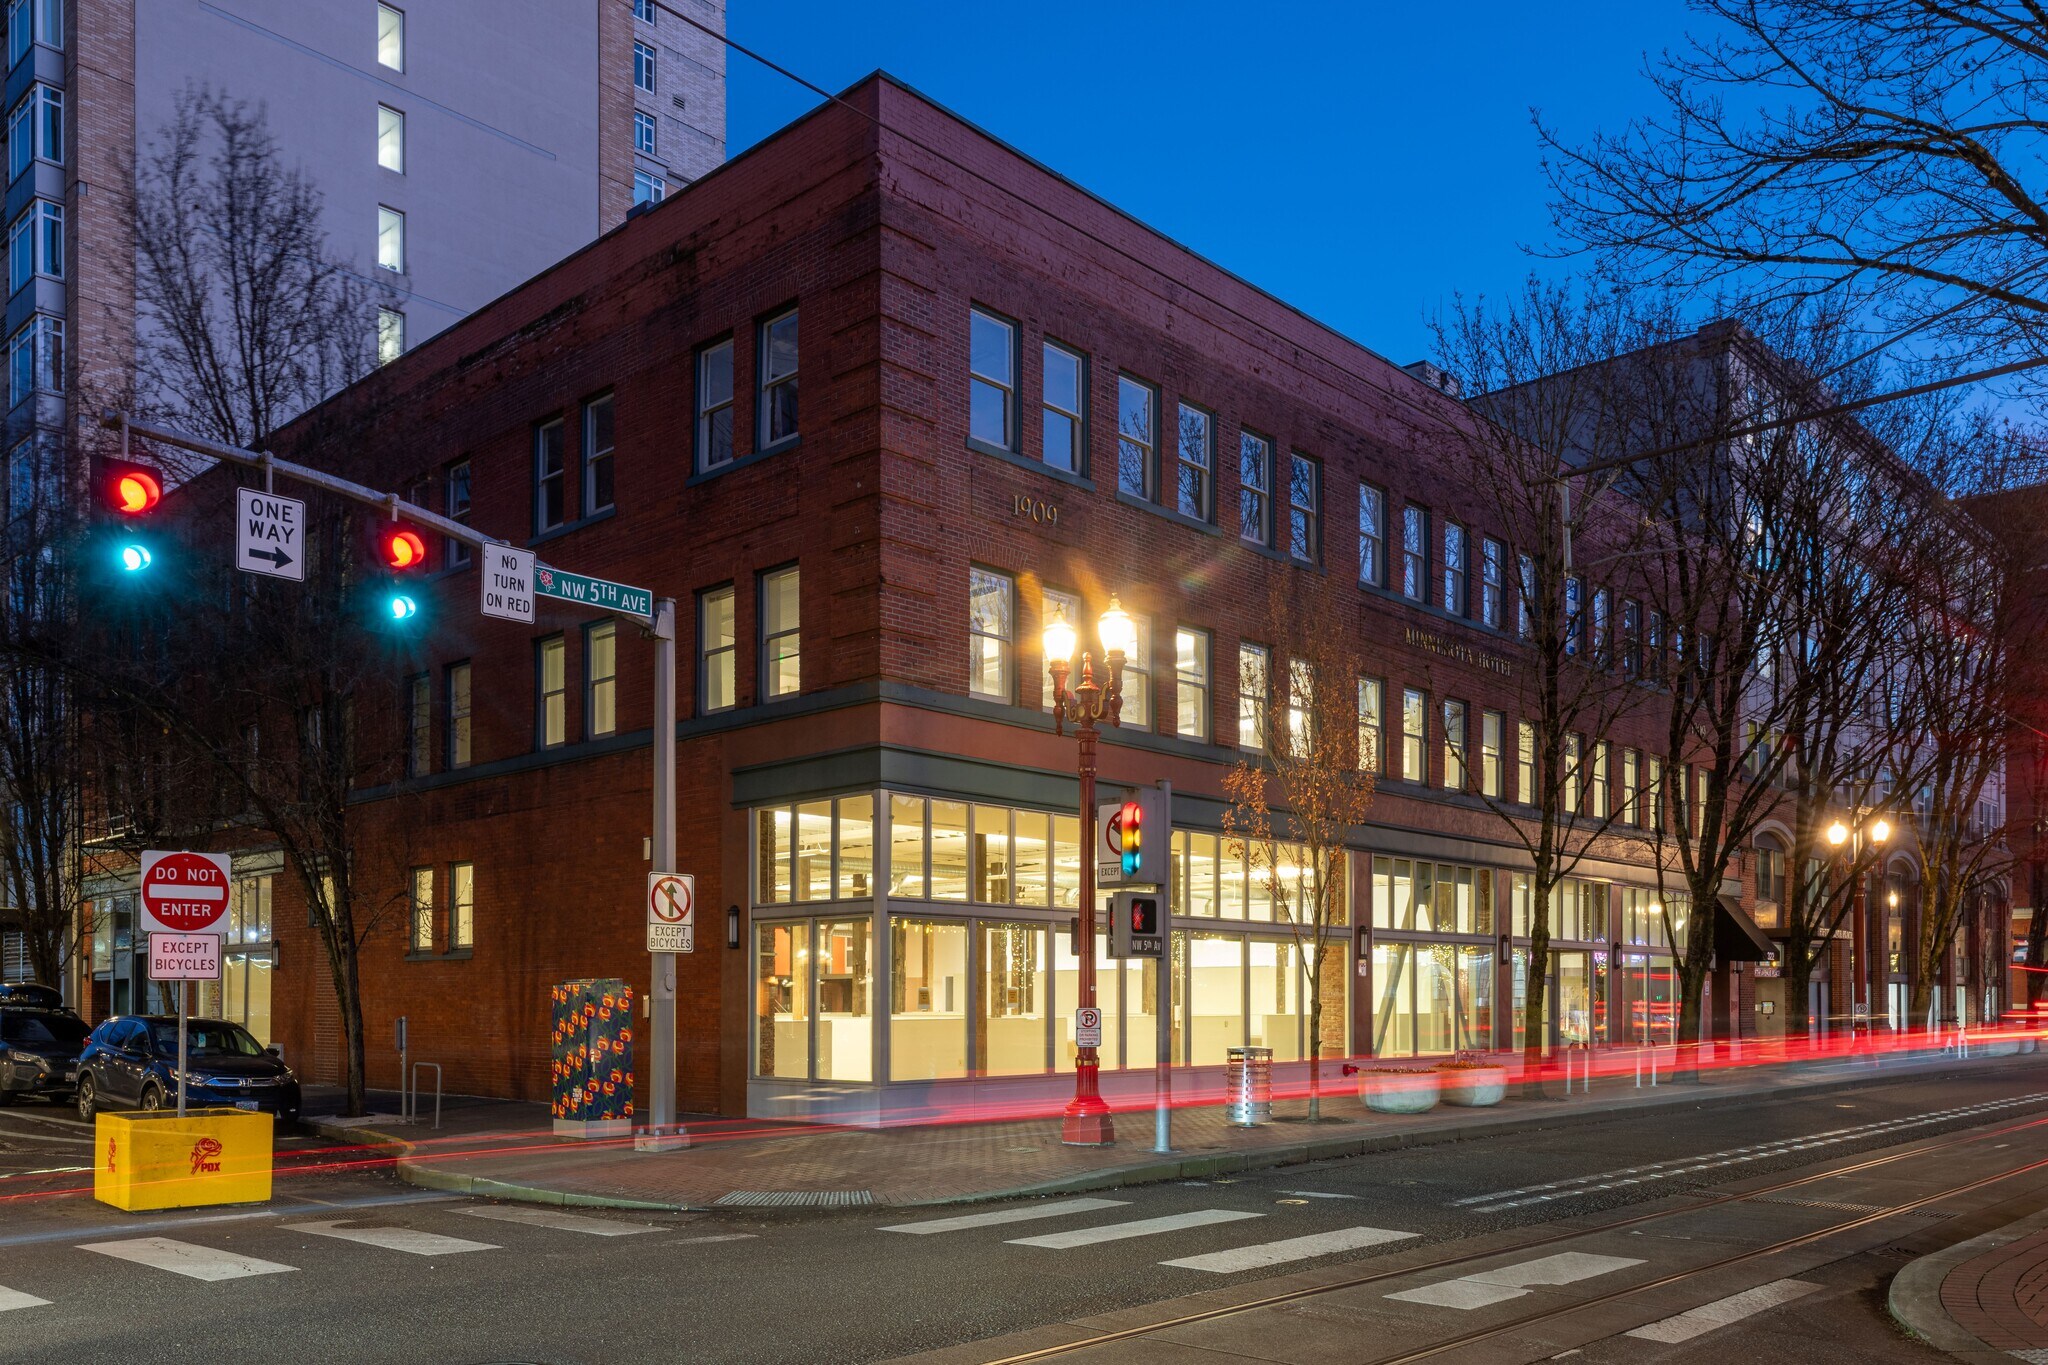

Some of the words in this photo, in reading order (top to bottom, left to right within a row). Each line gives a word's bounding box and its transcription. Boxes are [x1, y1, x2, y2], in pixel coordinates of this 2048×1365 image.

[251, 498, 293, 524] ONE
[1013, 495, 1058, 527] 1909
[249, 519, 295, 544] WAY
[501, 554, 518, 571] NO
[493, 573, 525, 593] TURN
[486, 592, 502, 609] ON
[507, 597, 531, 614] RED
[561, 580, 586, 599] NW
[590, 582, 617, 602] 5TH
[621, 593, 647, 613] AVE
[1405, 627, 1473, 665] MINNESOTA
[155, 867, 178, 880] DO
[187, 868, 218, 882] NOT
[1101, 867, 1120, 877] EXCEPT
[161, 903, 211, 917] ENTER
[655, 926, 687, 937] EXCEPT
[162, 941, 209, 954] EXCEPT
[650, 937, 691, 949] BICYCLES
[1132, 940, 1142, 951] NW
[1143, 939, 1152, 951] 5th
[155, 958, 215, 971] BICYCLES
[201, 1162, 221, 1172] PDX
